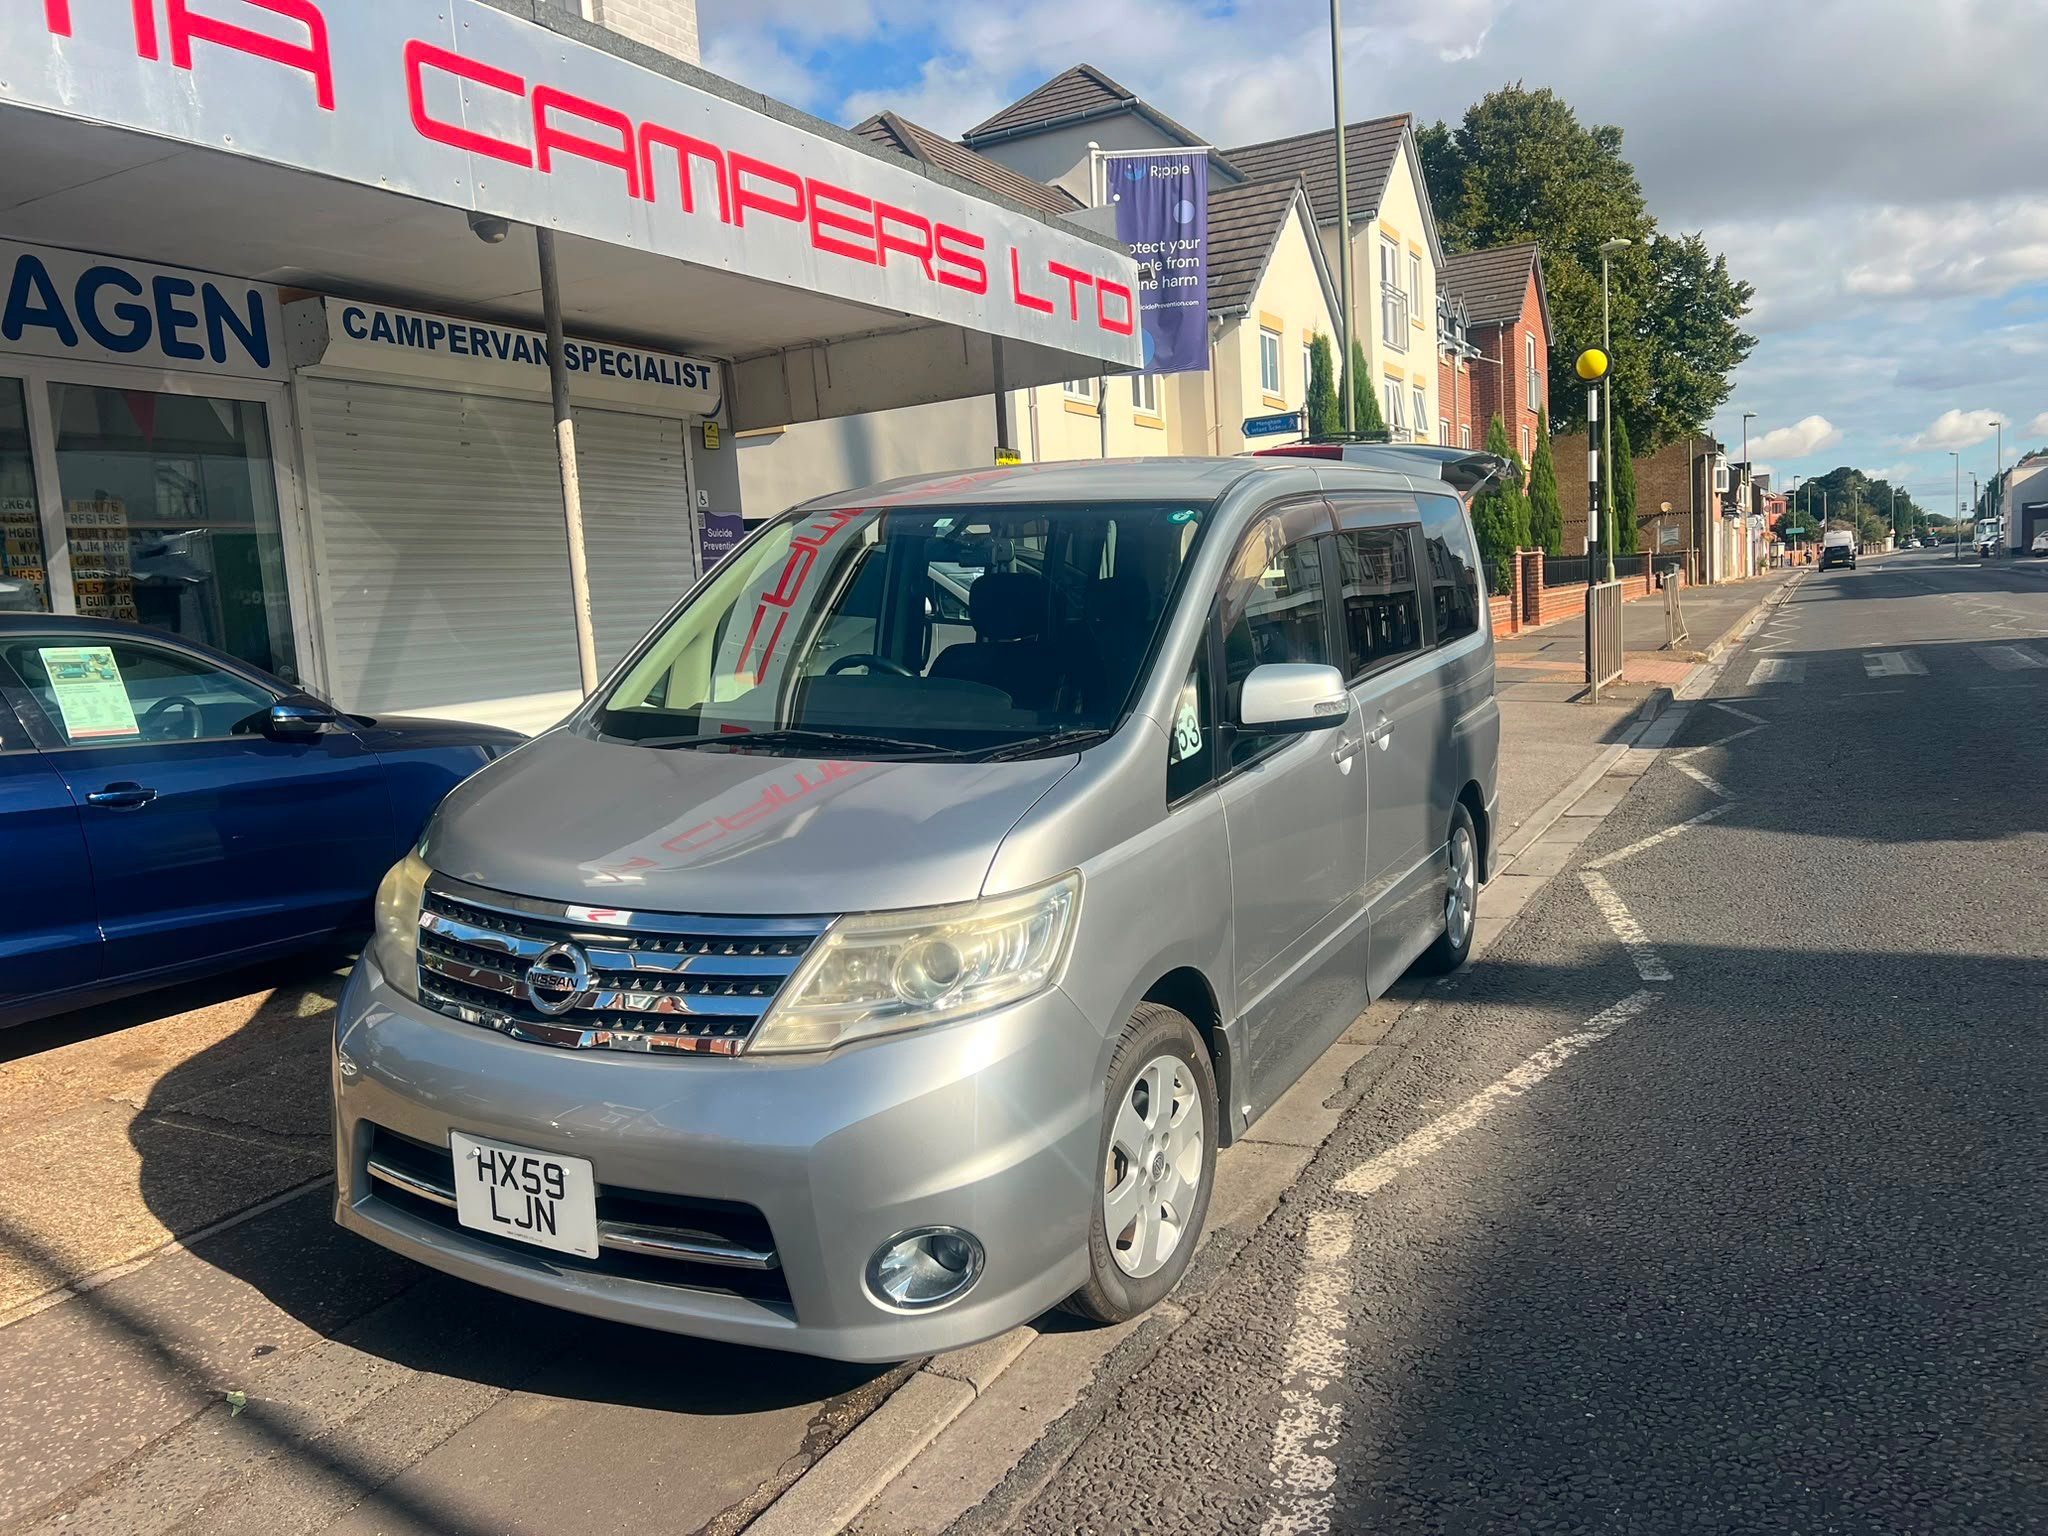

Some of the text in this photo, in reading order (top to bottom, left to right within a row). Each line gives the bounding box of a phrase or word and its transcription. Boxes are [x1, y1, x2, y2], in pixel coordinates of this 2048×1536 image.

[404, 38, 988, 296] CAMPERS
[1010, 247, 1134, 336] LTD
[1129, 238, 1201, 254] otect your
[1166, 256, 1200, 269] from
[1162, 275, 1198, 288] harm
[1, 254, 271, 369] AGEN
[341, 306, 711, 391] CAMPERVAN SPECIALIST
[707, 528, 733, 538] Suicide
[703, 541, 737, 551] Preventio
[528, 972, 579, 989] NISSAN
[476, 1146, 566, 1201] HX59
[490, 1185, 557, 1236] LJN
